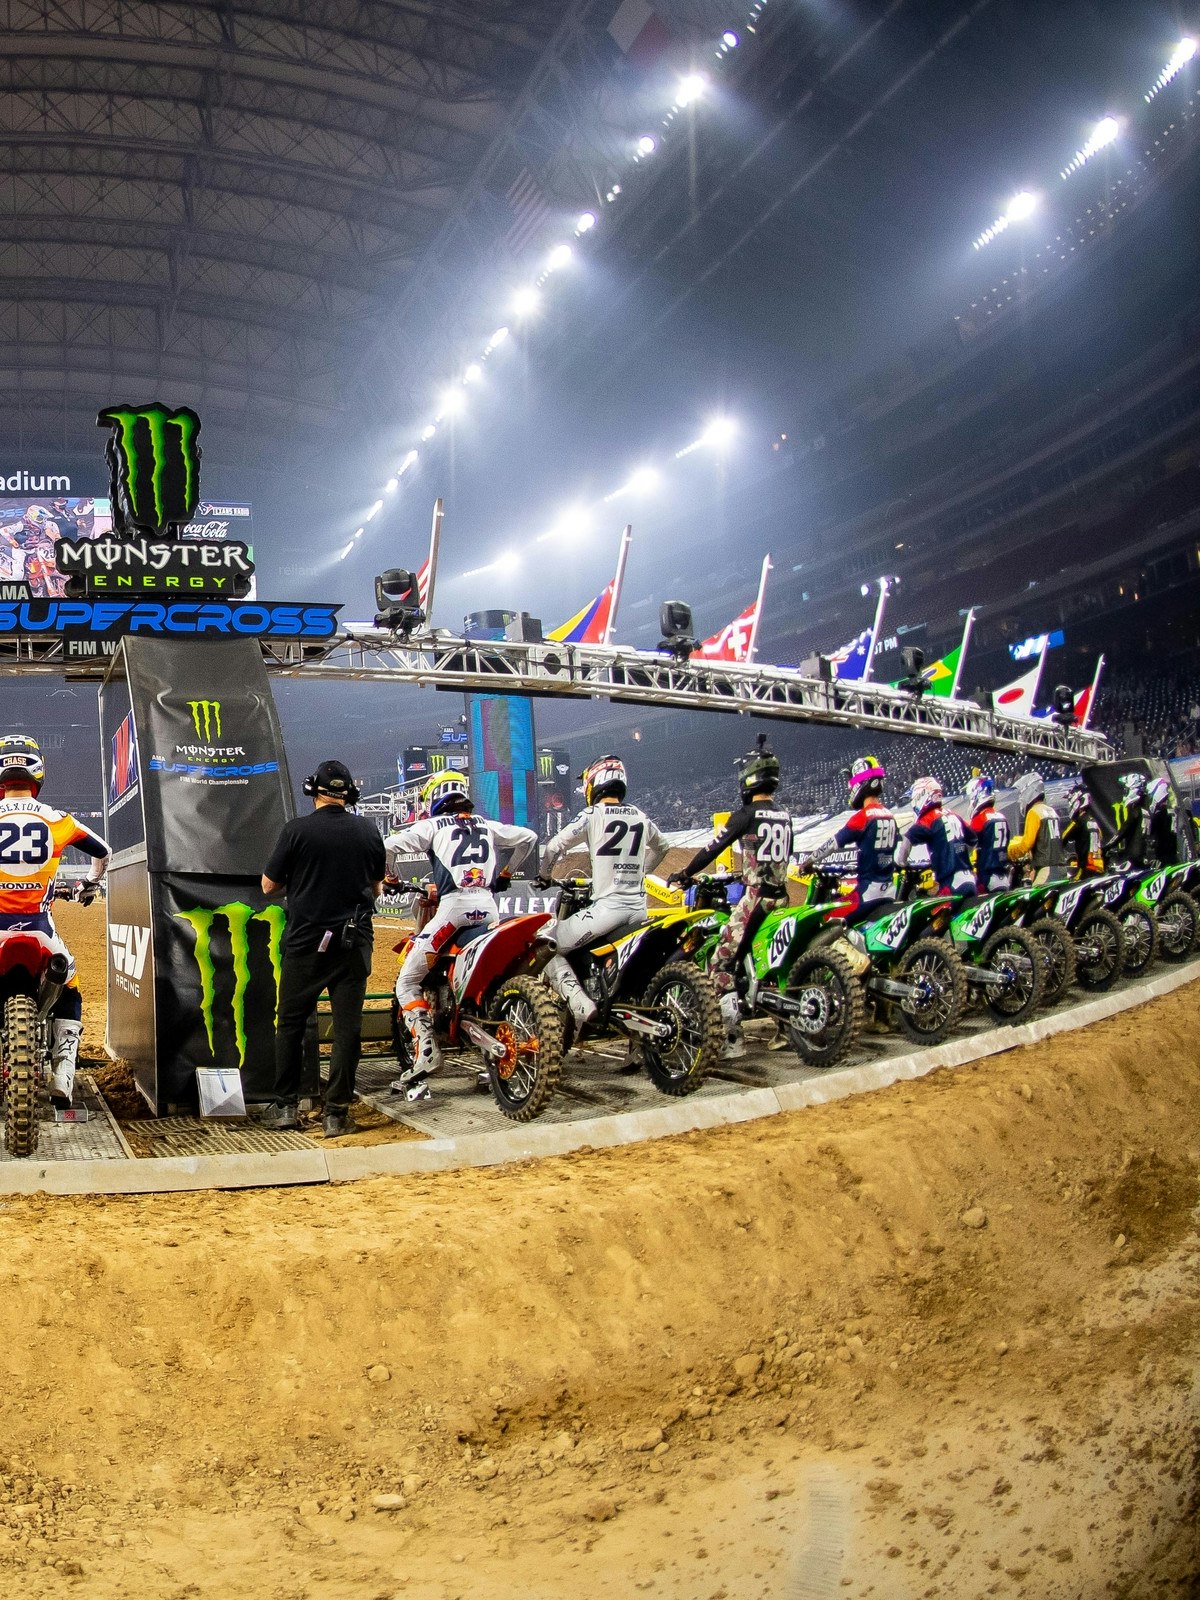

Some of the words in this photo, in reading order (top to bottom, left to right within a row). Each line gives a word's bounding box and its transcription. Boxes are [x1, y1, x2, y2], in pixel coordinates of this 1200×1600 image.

[183, 521, 230, 539] oca-Cola
[61, 538, 250, 571] MONSTER
[94, 575, 226, 588] ENERGY
[69, 642, 97, 655] FIM
[884, 636, 898, 651] PM
[152, 754, 166, 762] AMA
[175, 744, 246, 757] MONSTER
[3, 756, 27, 766] CHASE
[148, 761, 279, 777] SUPERCROSS
[191, 777, 208, 785] World
[208, 778, 249, 786] Championship
[604, 807, 639, 816] ANDERSON
[596, 820, 644, 856] 21
[451, 827, 490, 867] 25
[645, 883, 671, 899] DUNLOP
[499, 897, 556, 914] KLEY
[886, 909, 908, 945] 330
[971, 903, 993, 936] 309
[770, 918, 793, 965] 280
[108, 923, 151, 980] FLY
[116, 973, 140, 999] RACING
